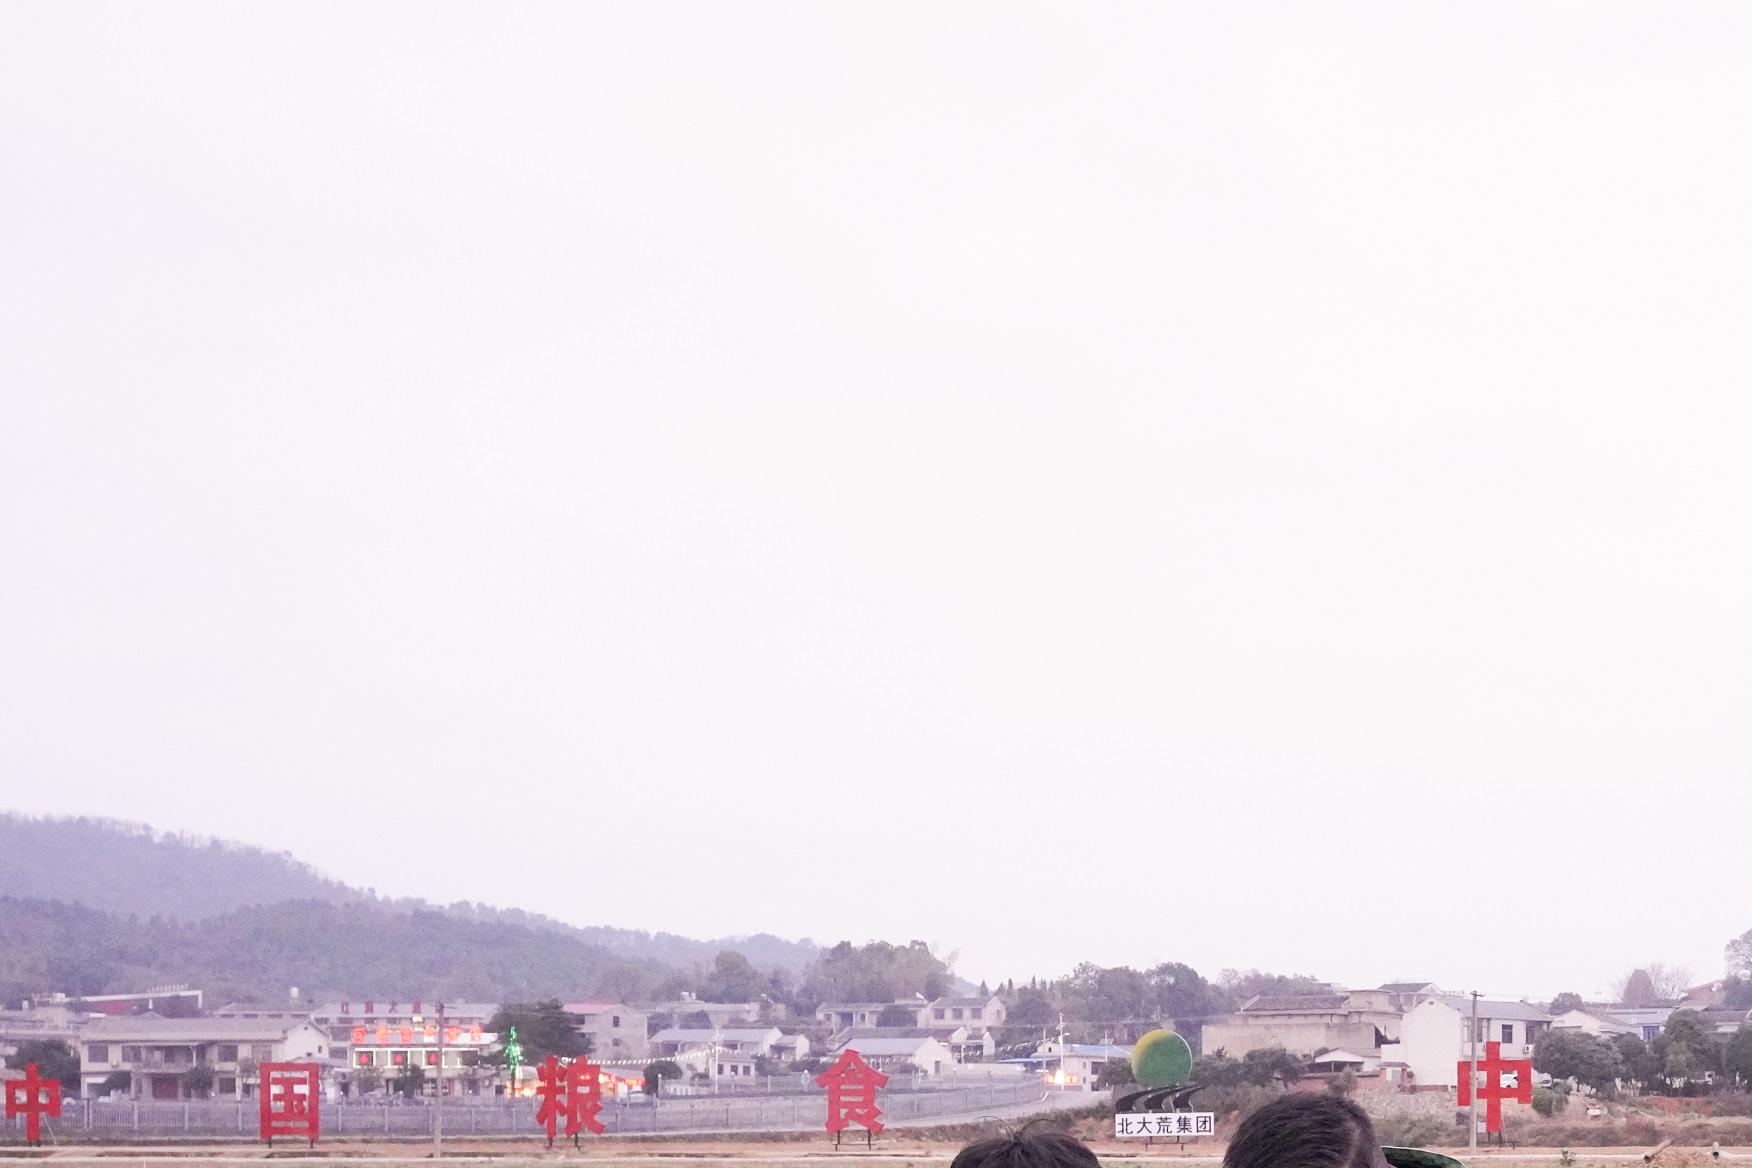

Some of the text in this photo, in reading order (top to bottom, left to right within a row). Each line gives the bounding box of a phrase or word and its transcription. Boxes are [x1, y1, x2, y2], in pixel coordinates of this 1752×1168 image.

[4, 1048, 889, 1142] 中 国 粮 食
[1116, 1114, 1212, 1135] 北大荒集团
[1456, 1040, 1533, 1133] 中
